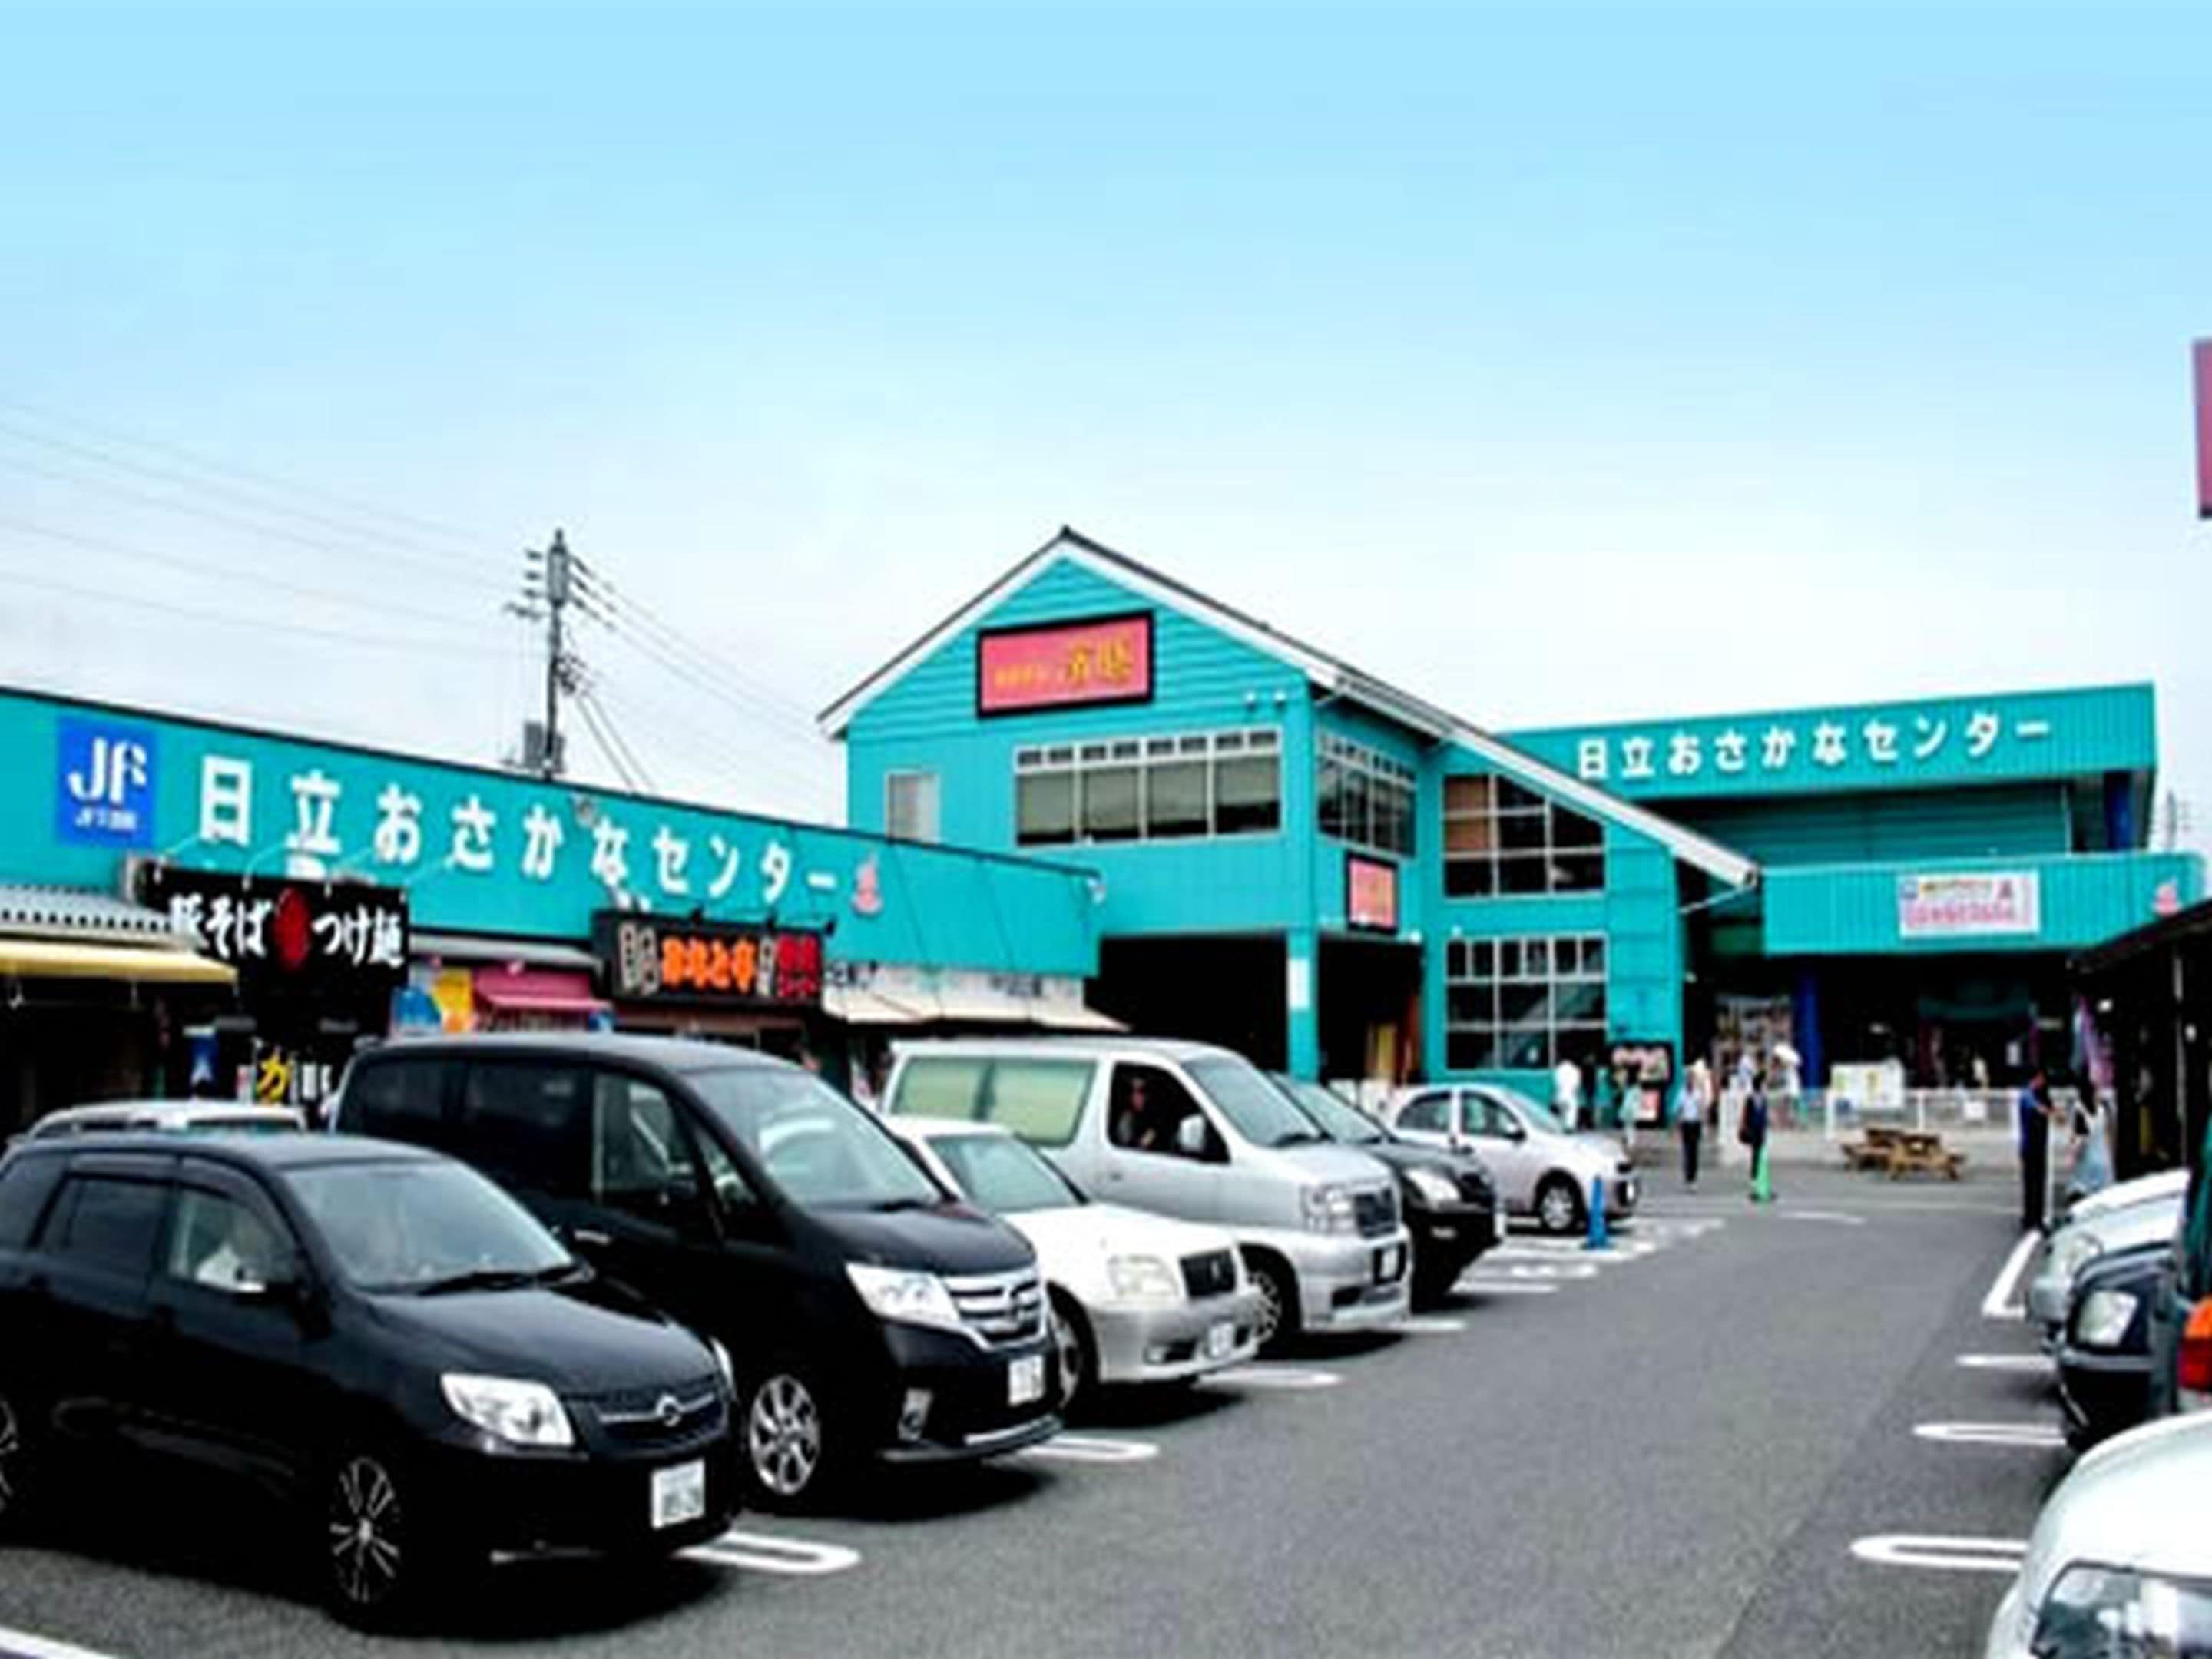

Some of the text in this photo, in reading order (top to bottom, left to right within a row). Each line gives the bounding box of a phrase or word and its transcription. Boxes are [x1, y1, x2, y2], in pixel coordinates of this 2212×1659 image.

[1578, 713, 2049, 780] 日立おさかなセンター
[200, 755, 837, 902] 日立おさかなセンター
